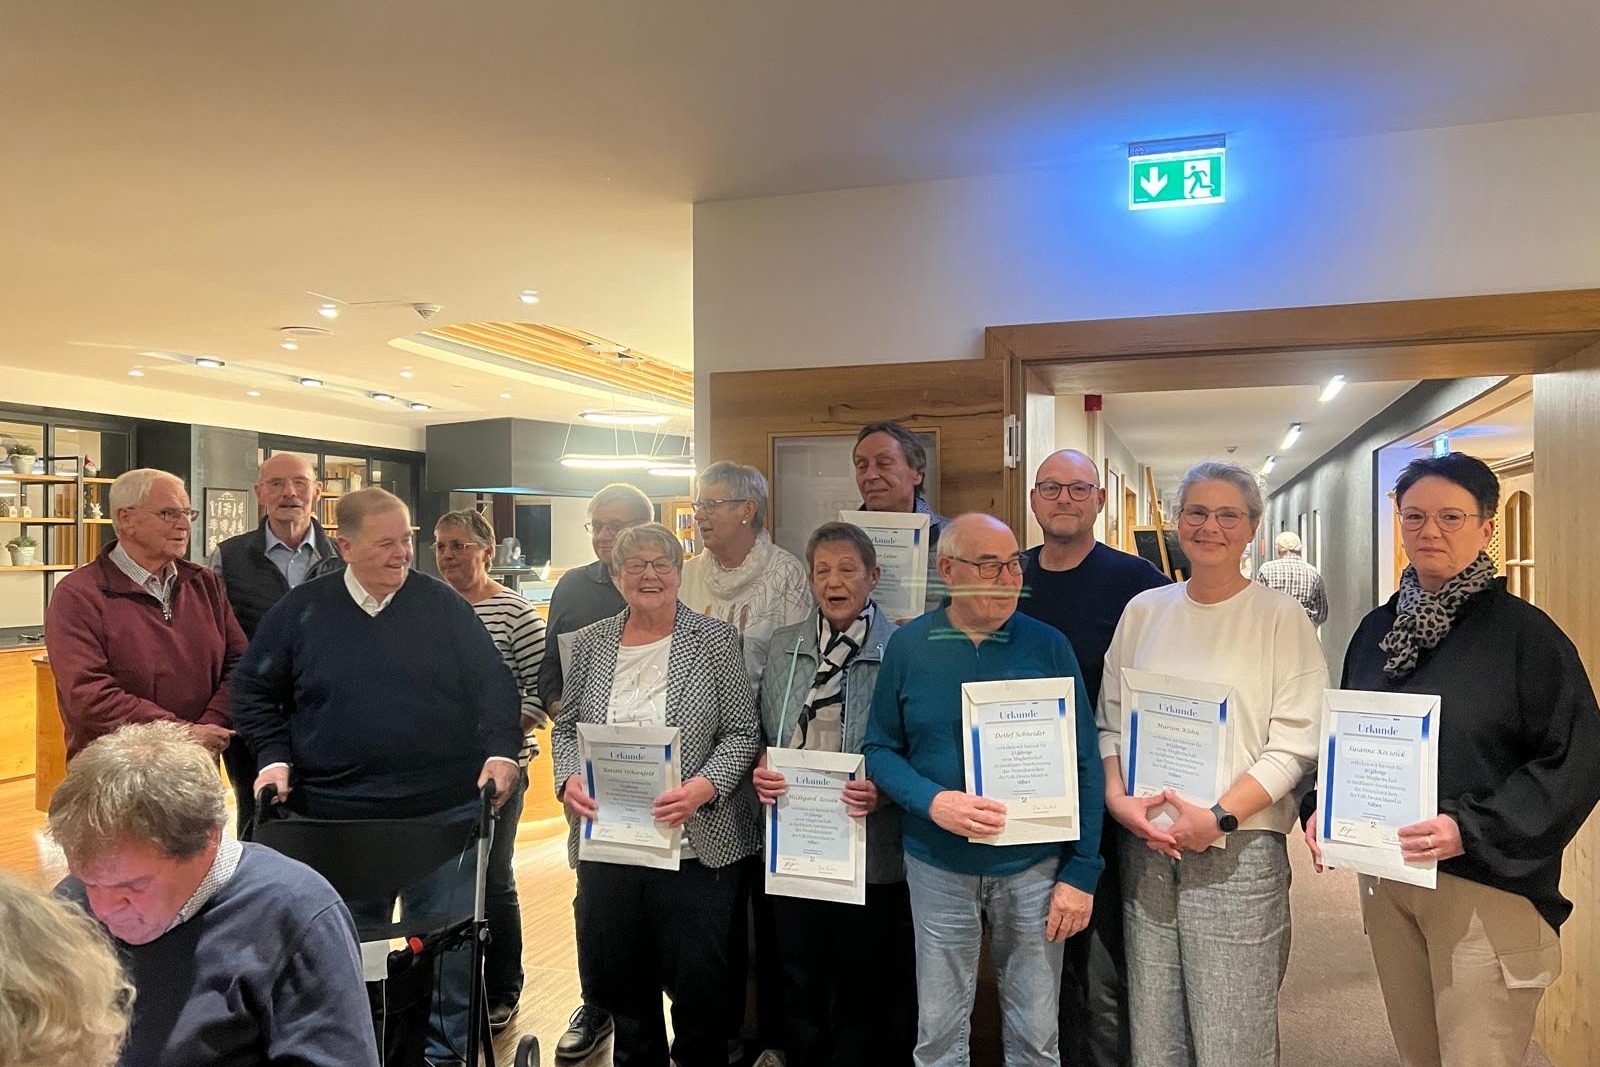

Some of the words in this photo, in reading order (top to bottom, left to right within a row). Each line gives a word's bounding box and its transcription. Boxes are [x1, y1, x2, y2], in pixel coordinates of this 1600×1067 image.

[999, 709, 1039, 720] Urkunde
[1159, 703, 1199, 717] Urkunde
[1157, 722, 1180, 732] Marion
[1358, 724, 1399, 736] Urkunde
[994, 731, 1014, 739] Detlef
[1015, 730, 1046, 738] Schneider
[1349, 746, 1375, 754] Susanne
[610, 751, 646, 761] Urkunde
[796, 776, 831, 786] Urkunde
